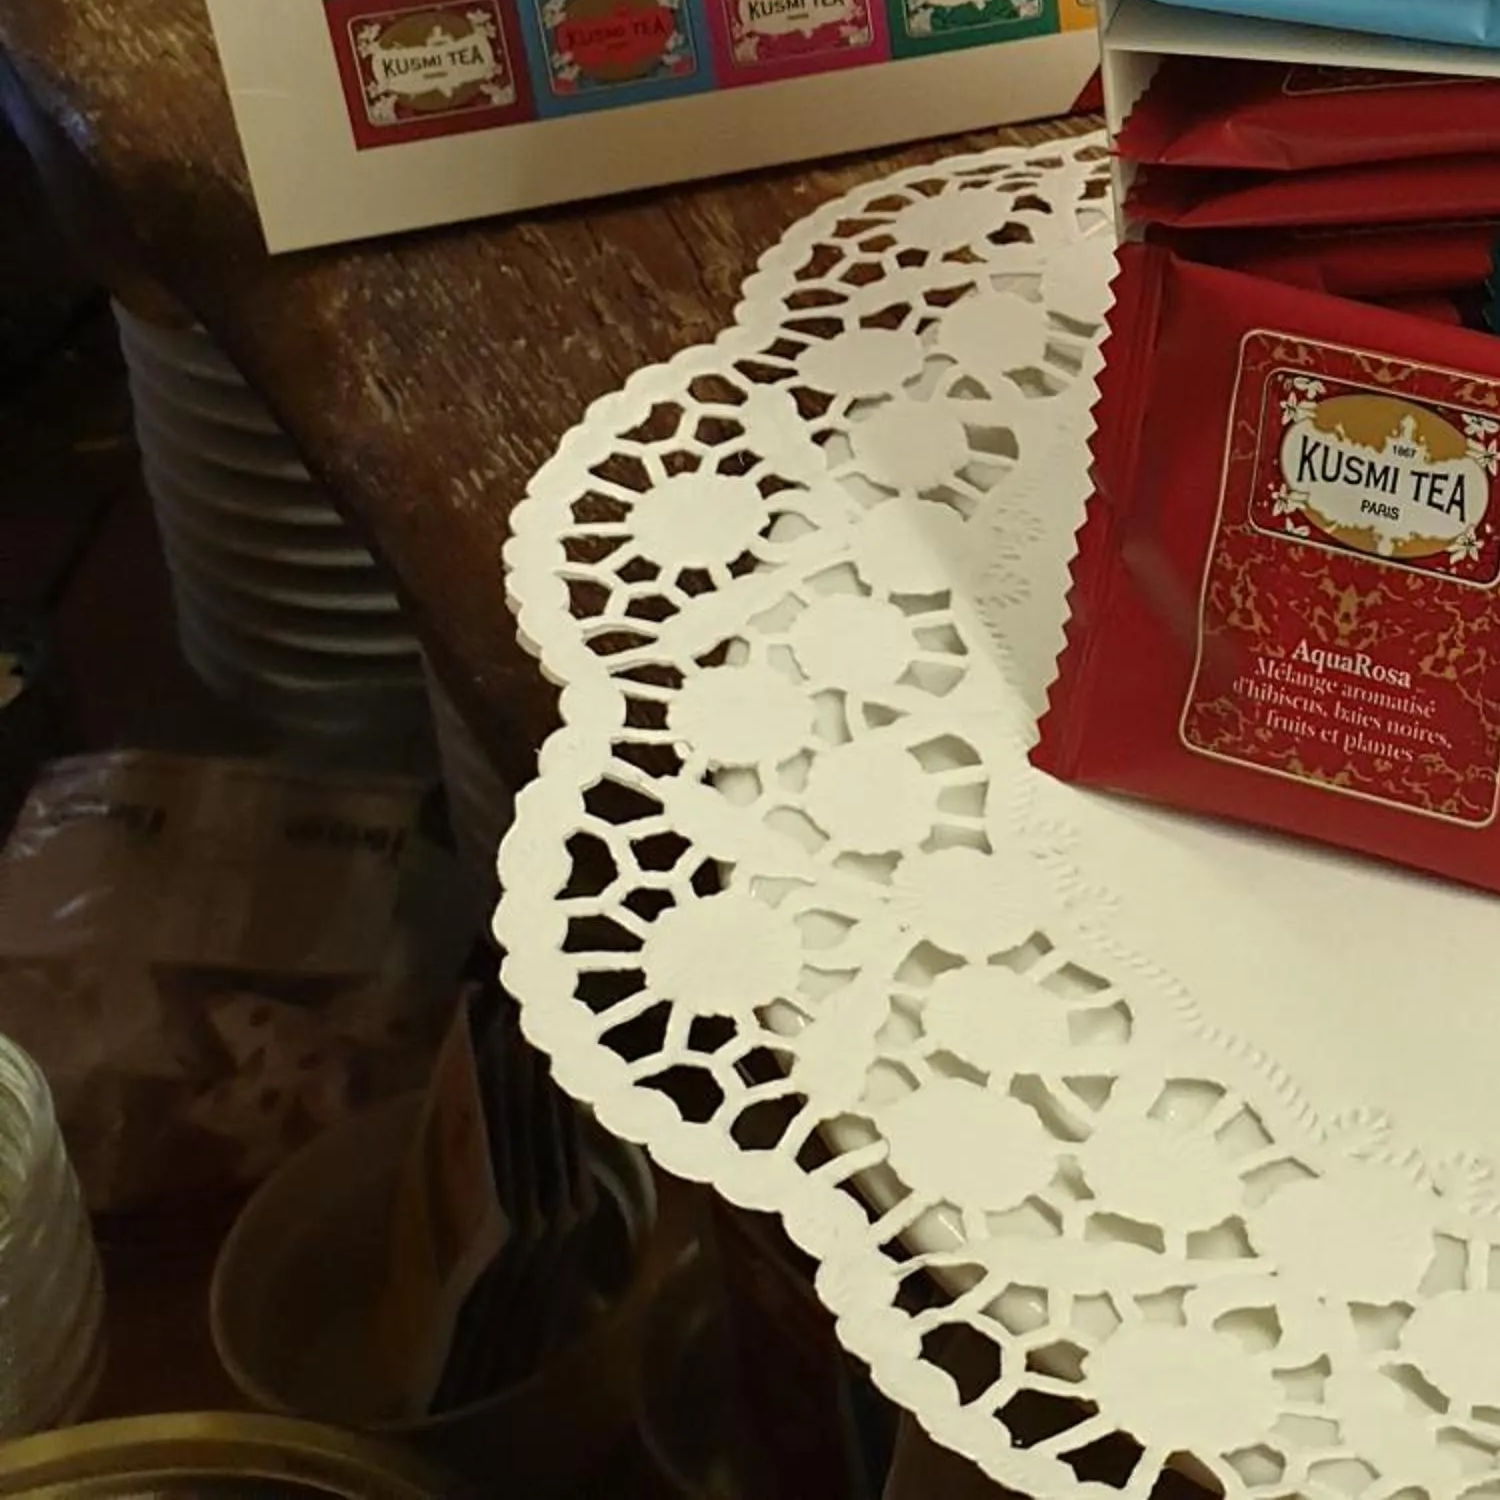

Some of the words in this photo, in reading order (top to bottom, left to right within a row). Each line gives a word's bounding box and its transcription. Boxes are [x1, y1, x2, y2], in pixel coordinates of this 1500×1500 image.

[381, 53, 442, 78] KUSMI
[447, 44, 485, 68] TEA
[1296, 435, 1400, 495] KUSMI
[1410, 470, 1467, 523] TEA
[1360, 499, 1400, 521] PARIS
[1254, 657, 1339, 696] Mélange
[1341, 682, 1437, 720] aromatisé
[1291, 638, 1412, 690] AquaRosa
[1265, 708, 1316, 739] fruits
[1320, 726, 1340, 745] et
[1342, 730, 1414, 763] plantes
[1333, 699, 1382, 730] baies
